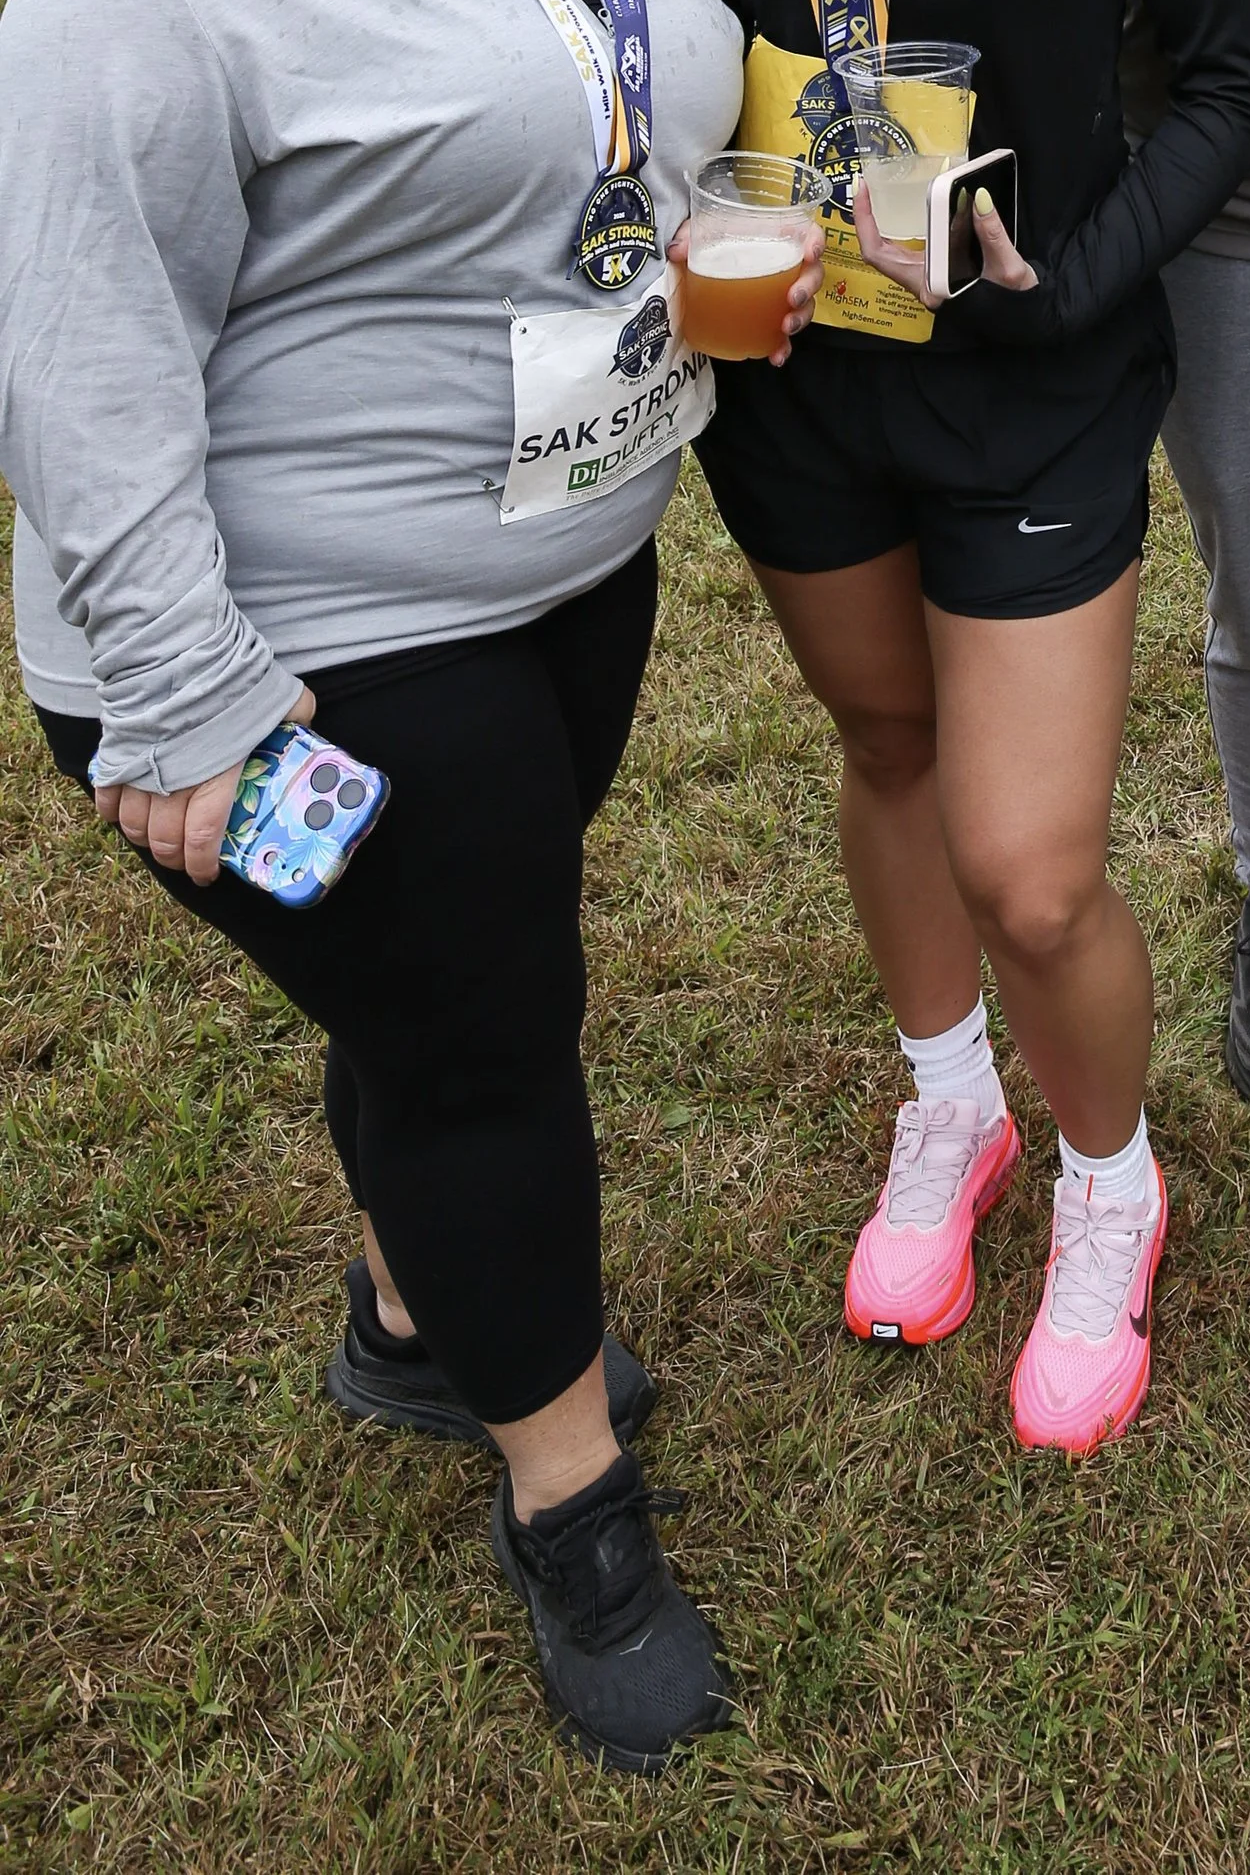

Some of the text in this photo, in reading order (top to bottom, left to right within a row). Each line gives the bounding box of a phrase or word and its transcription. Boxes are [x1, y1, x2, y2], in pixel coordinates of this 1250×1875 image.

[566, 4, 584, 33] Youth
[565, 31, 596, 82] SAK
[582, 35, 596, 55] and
[592, 58, 605, 86] Walk
[602, 88, 611, 113] Mile
[802, 100, 826, 110] SAK
[818, 119, 906, 153] NO ONE FIGHTS ALONE
[824, 161, 846, 177] AK
[832, 173, 850, 183] Walk
[588, 181, 649, 222] NO ONE FIGHTS ALONE
[582, 225, 654, 257] SAK STRONG
[602, 251, 633, 281] 5K
[619, 321, 668, 361] SAK STRONG
[517, 416, 602, 464] SAK
[572, 404, 680, 485] Di DUFFY
